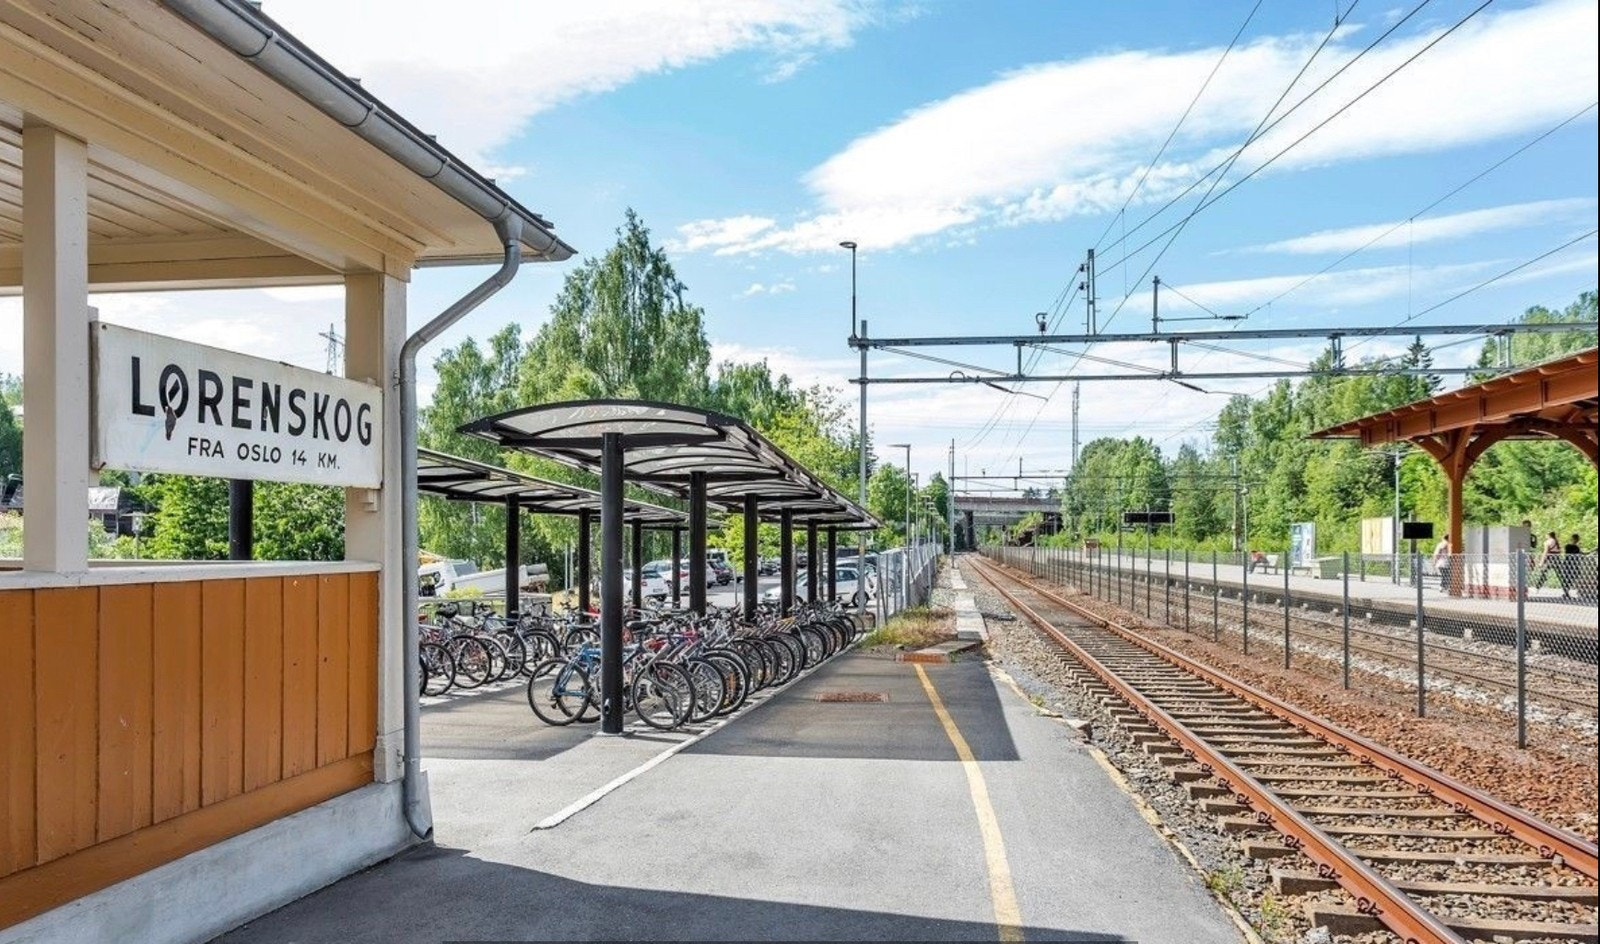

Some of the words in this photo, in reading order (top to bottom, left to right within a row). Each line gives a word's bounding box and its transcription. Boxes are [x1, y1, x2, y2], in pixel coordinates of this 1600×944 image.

[131, 356, 372, 447] LØRENSKOG
[187, 437, 224, 459] FRA
[237, 442, 282, 464] OSLO
[292, 449, 307, 466] 14
[318, 452, 341, 470] KM.
